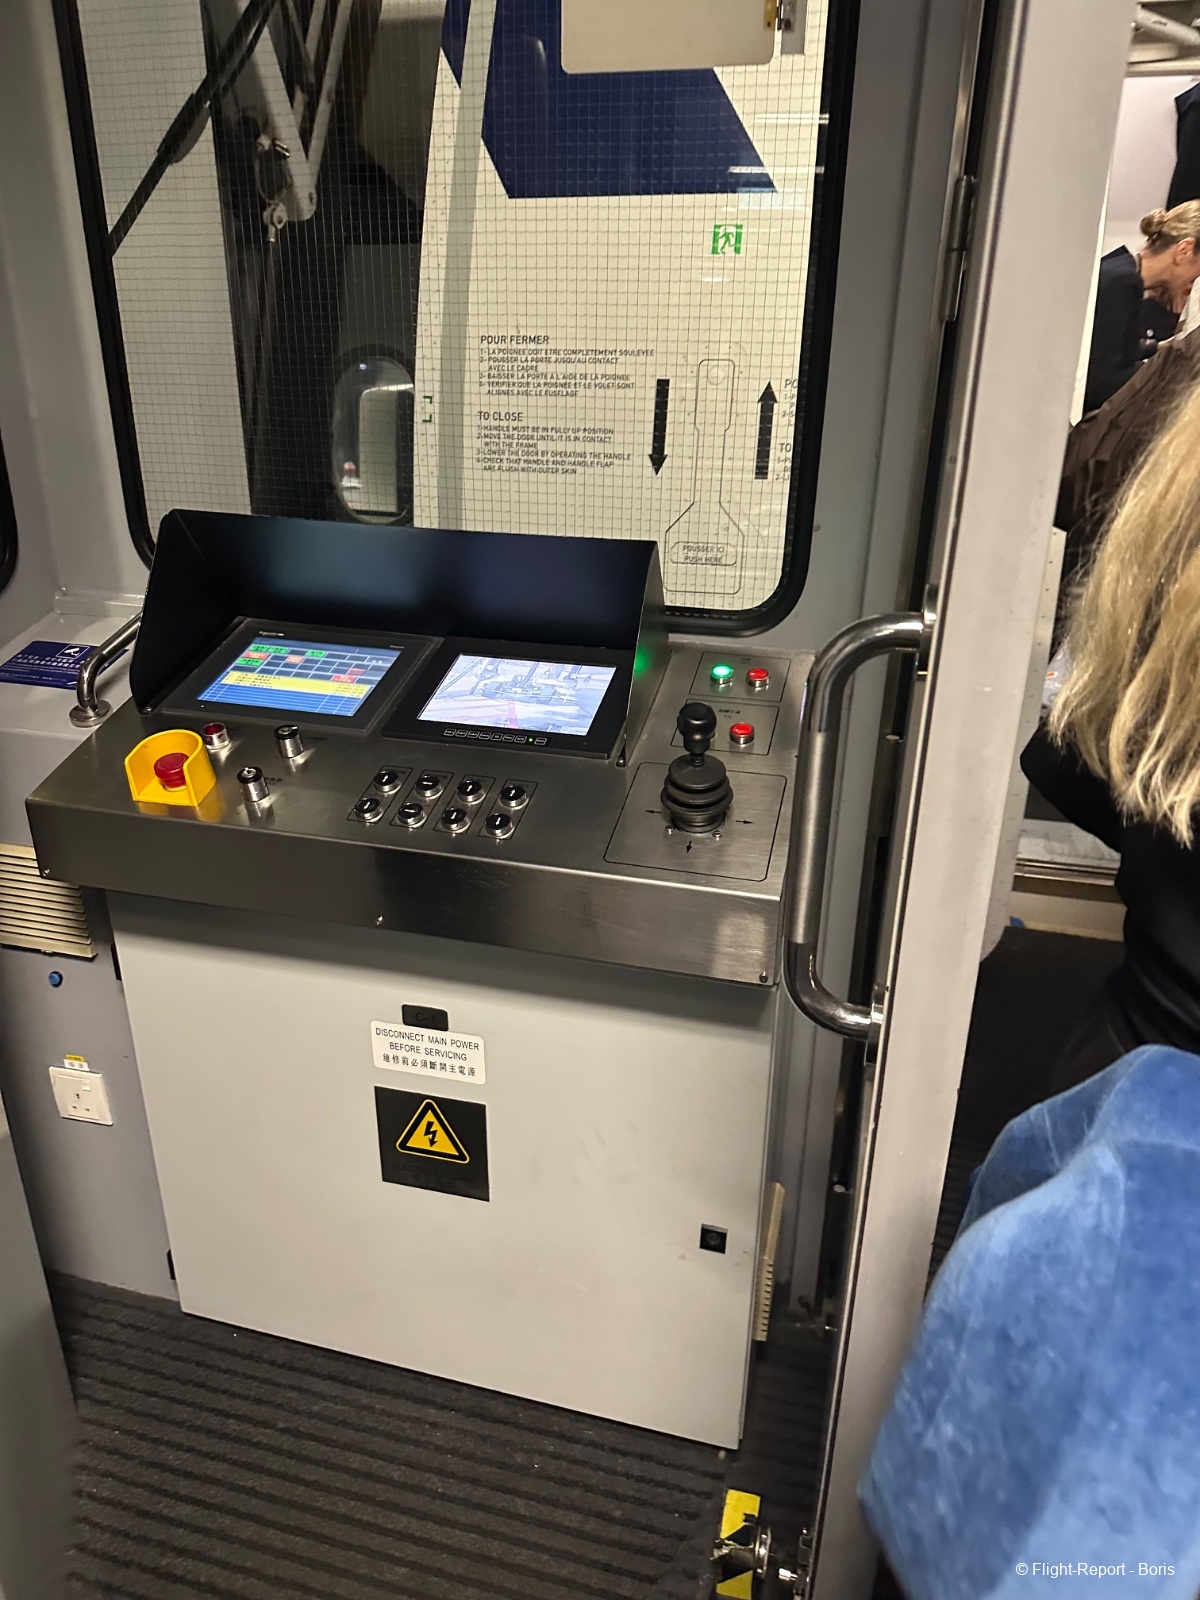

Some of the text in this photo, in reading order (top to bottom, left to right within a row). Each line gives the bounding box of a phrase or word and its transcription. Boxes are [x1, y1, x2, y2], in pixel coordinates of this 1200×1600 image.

[480, 335, 550, 345] POUR FERMER
[478, 411, 523, 422] TO CLOSE
[779, 443, 792, 452] TO
[375, 1027, 480, 1051] DISCONNECT MAIN POWER
[389, 1041, 467, 1061] BEFORE SERVICING
